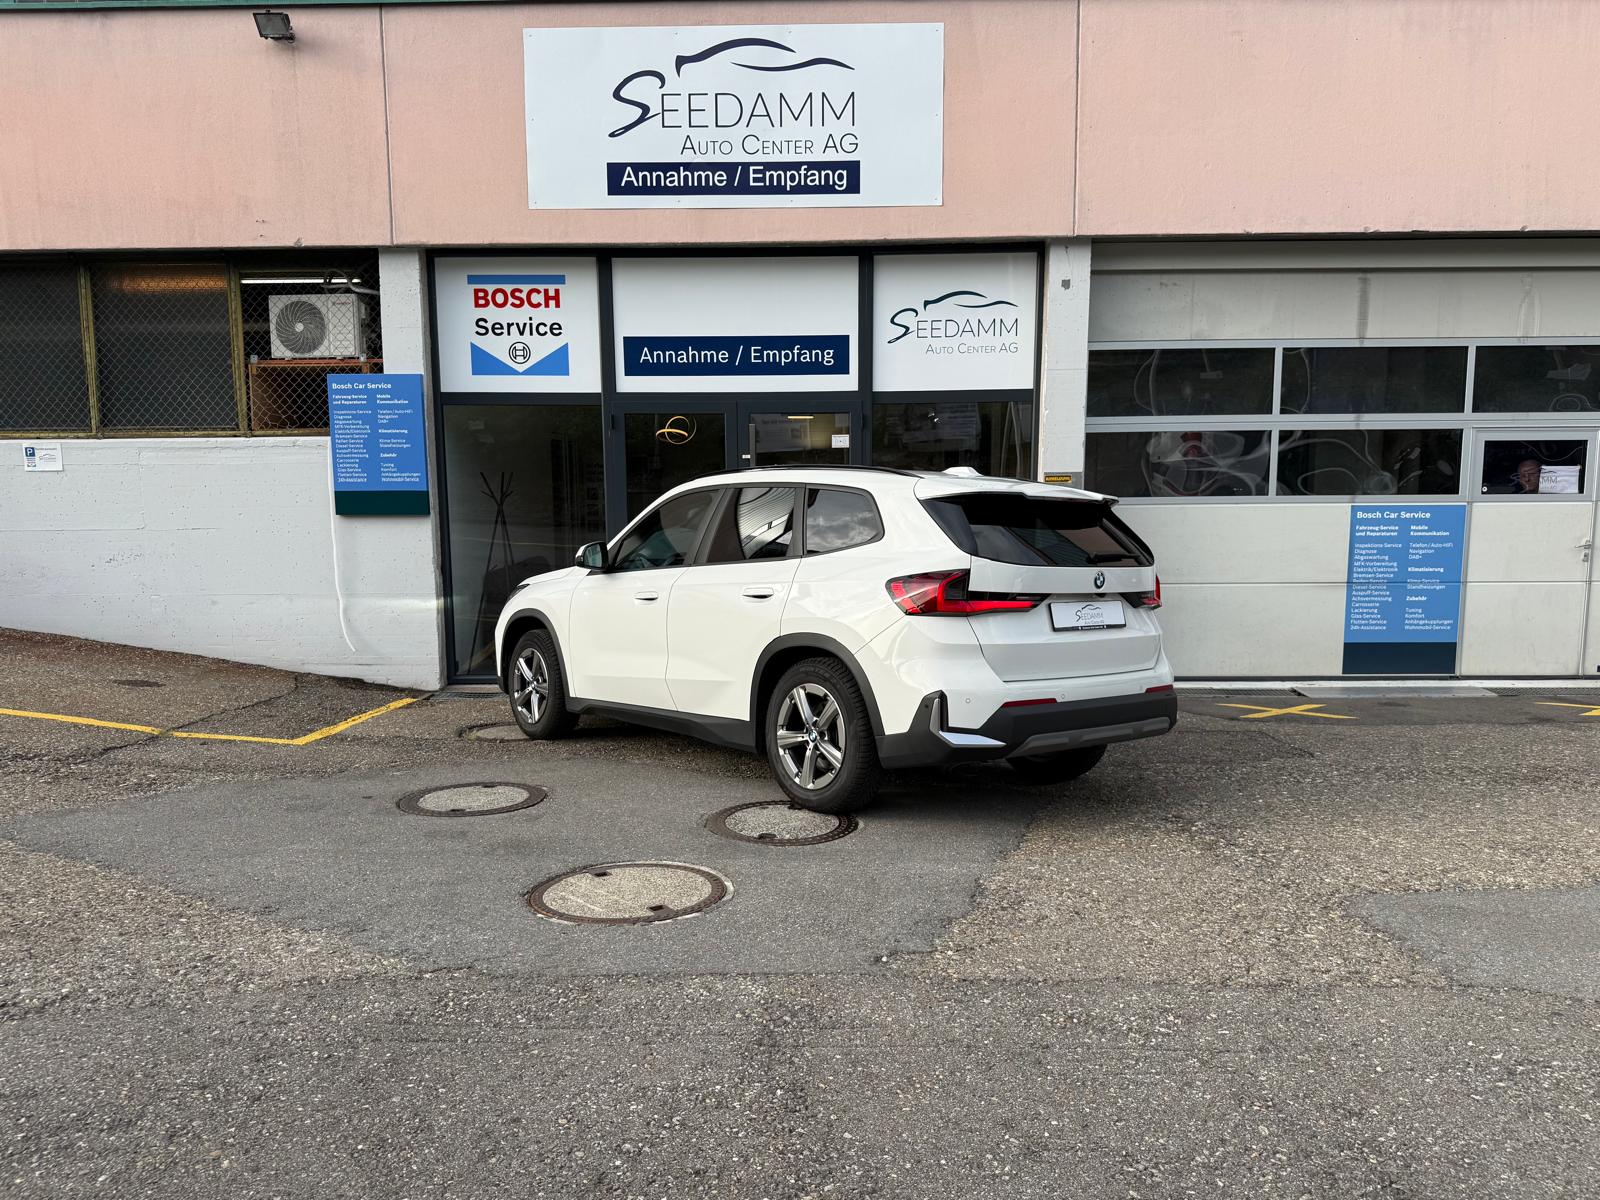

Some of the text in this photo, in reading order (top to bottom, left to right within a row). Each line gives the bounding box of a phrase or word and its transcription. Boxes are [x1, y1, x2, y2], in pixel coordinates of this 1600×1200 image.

[608, 69, 856, 138] SEEDAMM
[822, 132, 859, 155] AG
[621, 165, 848, 190] Annahme / Empfang
[473, 287, 561, 310] BOSCH
[474, 316, 563, 338] Service
[887, 307, 1019, 344] SEEDAMM
[639, 345, 835, 367] Annahme / Empfang
[999, 341, 1019, 354] AG
[27, 448, 33, 457] P
